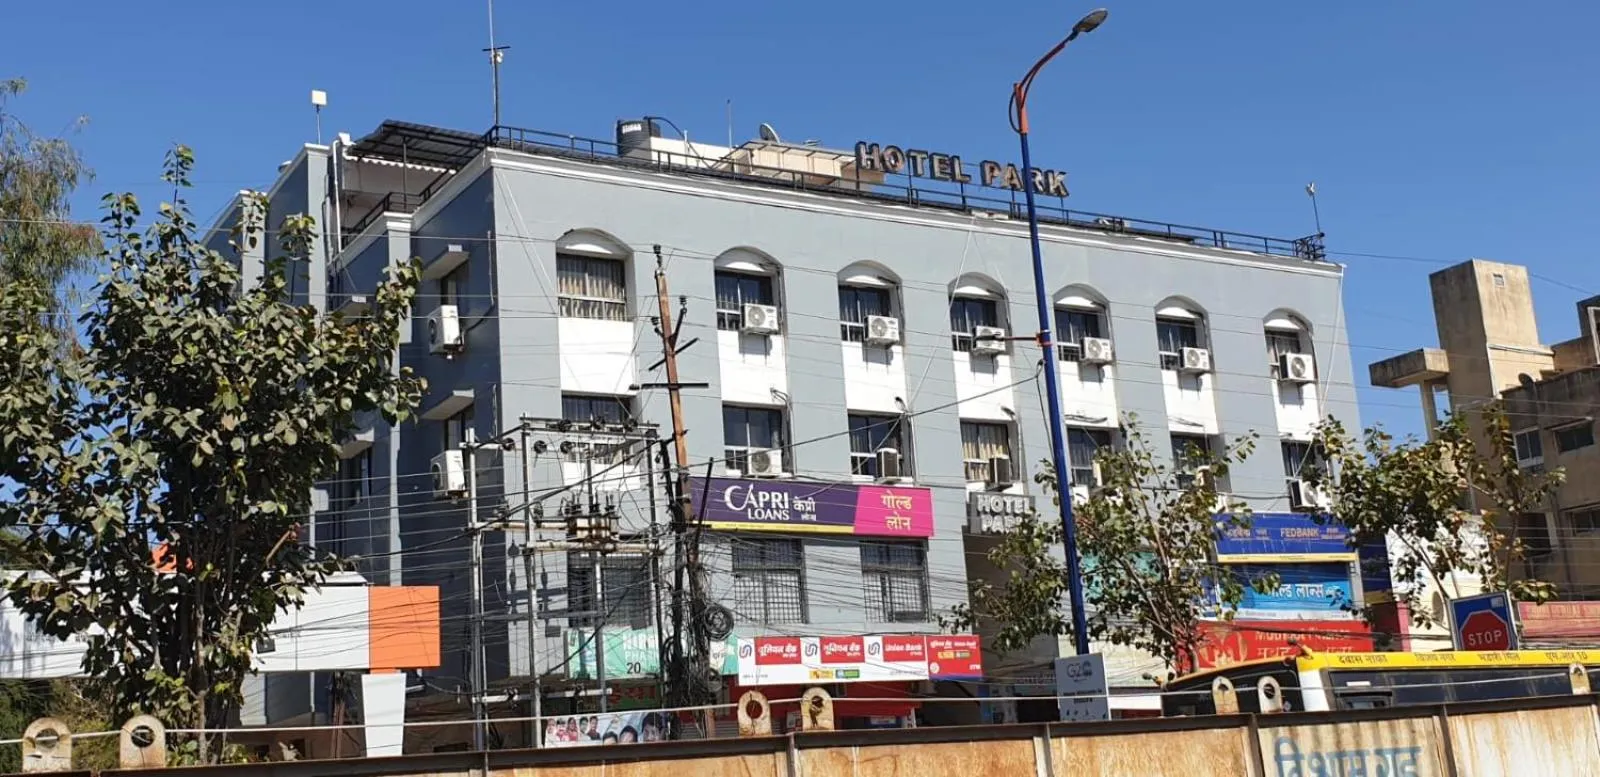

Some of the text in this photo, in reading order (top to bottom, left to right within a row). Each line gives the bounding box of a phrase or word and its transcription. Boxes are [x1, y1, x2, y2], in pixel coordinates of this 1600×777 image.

[855, 141, 1070, 198] HOTEL PARK
[724, 484, 789, 511] CAPRI
[881, 489, 913, 513] गोल्ड
[976, 494, 1033, 514] HOTEL
[747, 508, 790, 521] LOANS
[885, 511, 912, 532] लोन
[981, 514, 1023, 534] PAR
[1280, 527, 1319, 539] FEDBANK
[1468, 631, 1502, 647] STOP
[626, 661, 641, 675] 20
